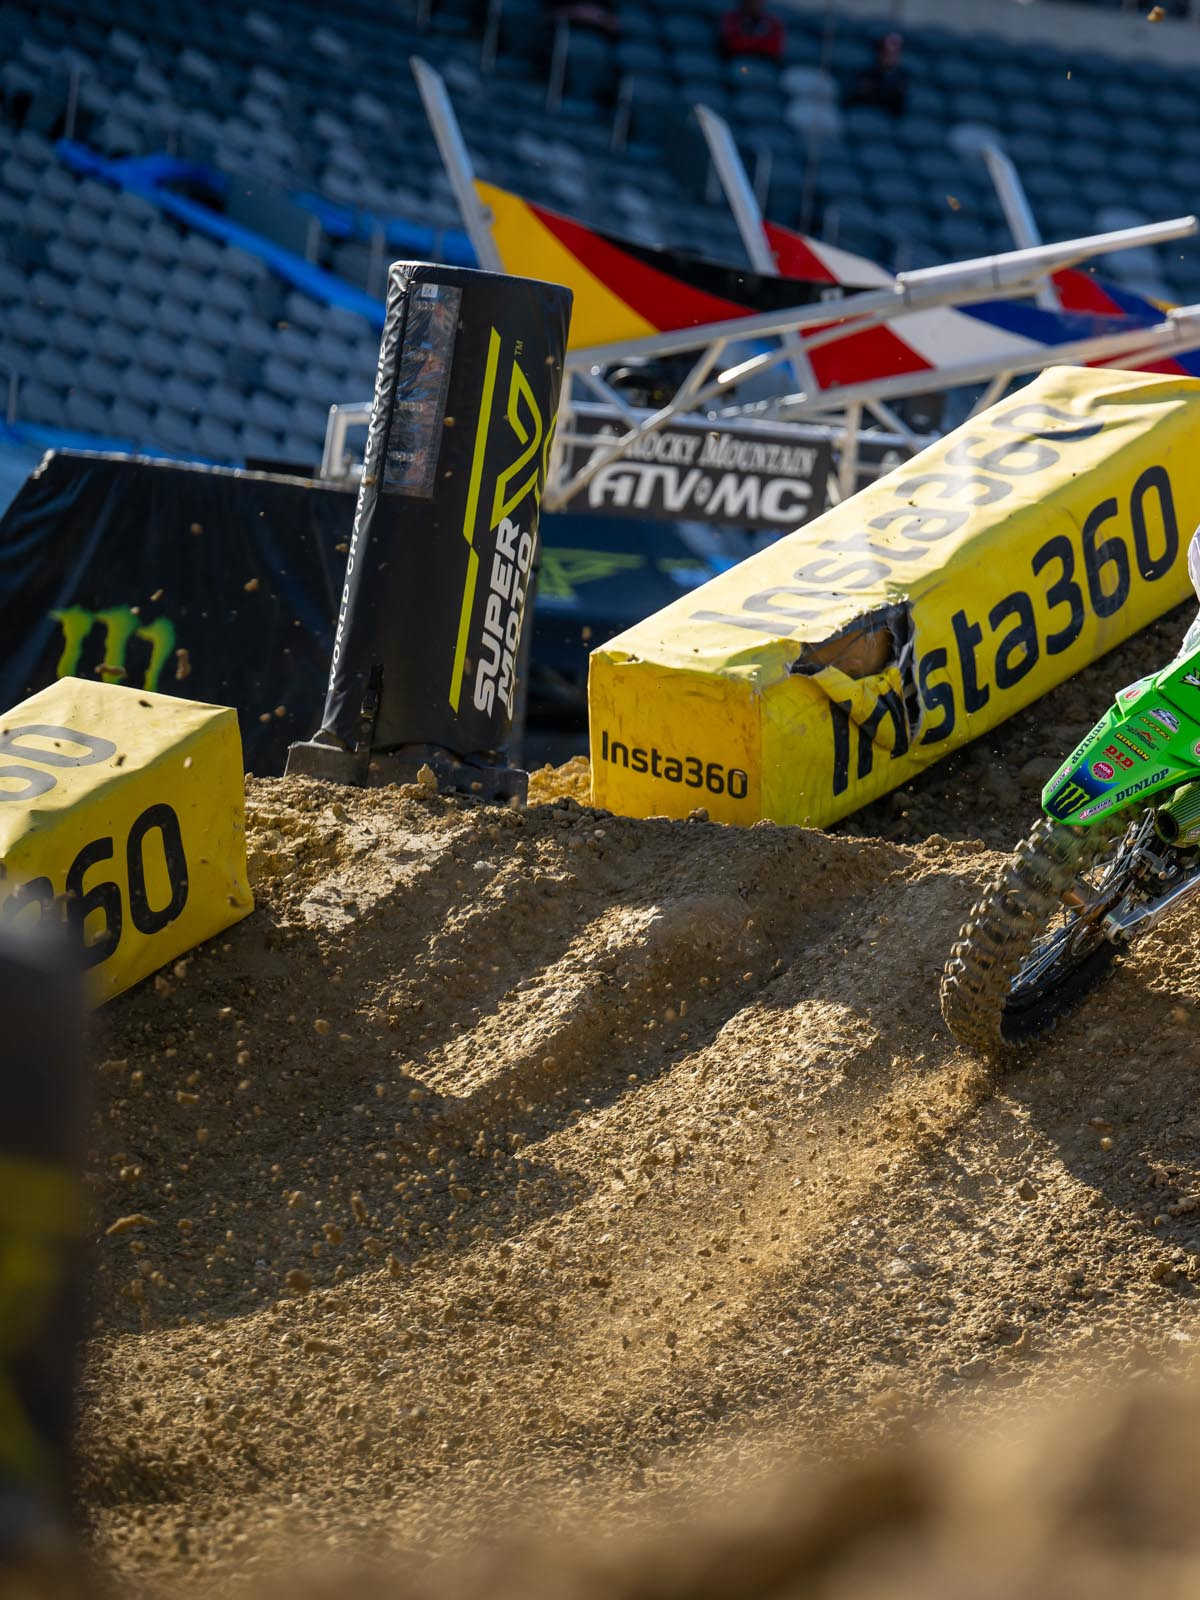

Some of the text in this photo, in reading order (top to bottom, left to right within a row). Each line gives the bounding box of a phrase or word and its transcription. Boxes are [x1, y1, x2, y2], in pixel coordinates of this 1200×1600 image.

[700, 433, 818, 477] MOUNTAIN
[689, 403, 1104, 635] Insta360
[328, 583, 350, 691] WORLD
[474, 517, 520, 719] SUPER
[833, 465, 1179, 796] Insta360
[602, 730, 748, 799] Insta360
[1071, 721, 1106, 764] DUNLOP
[1116, 733, 1149, 761] HINSON
[1115, 768, 1169, 803] DUNLOP
